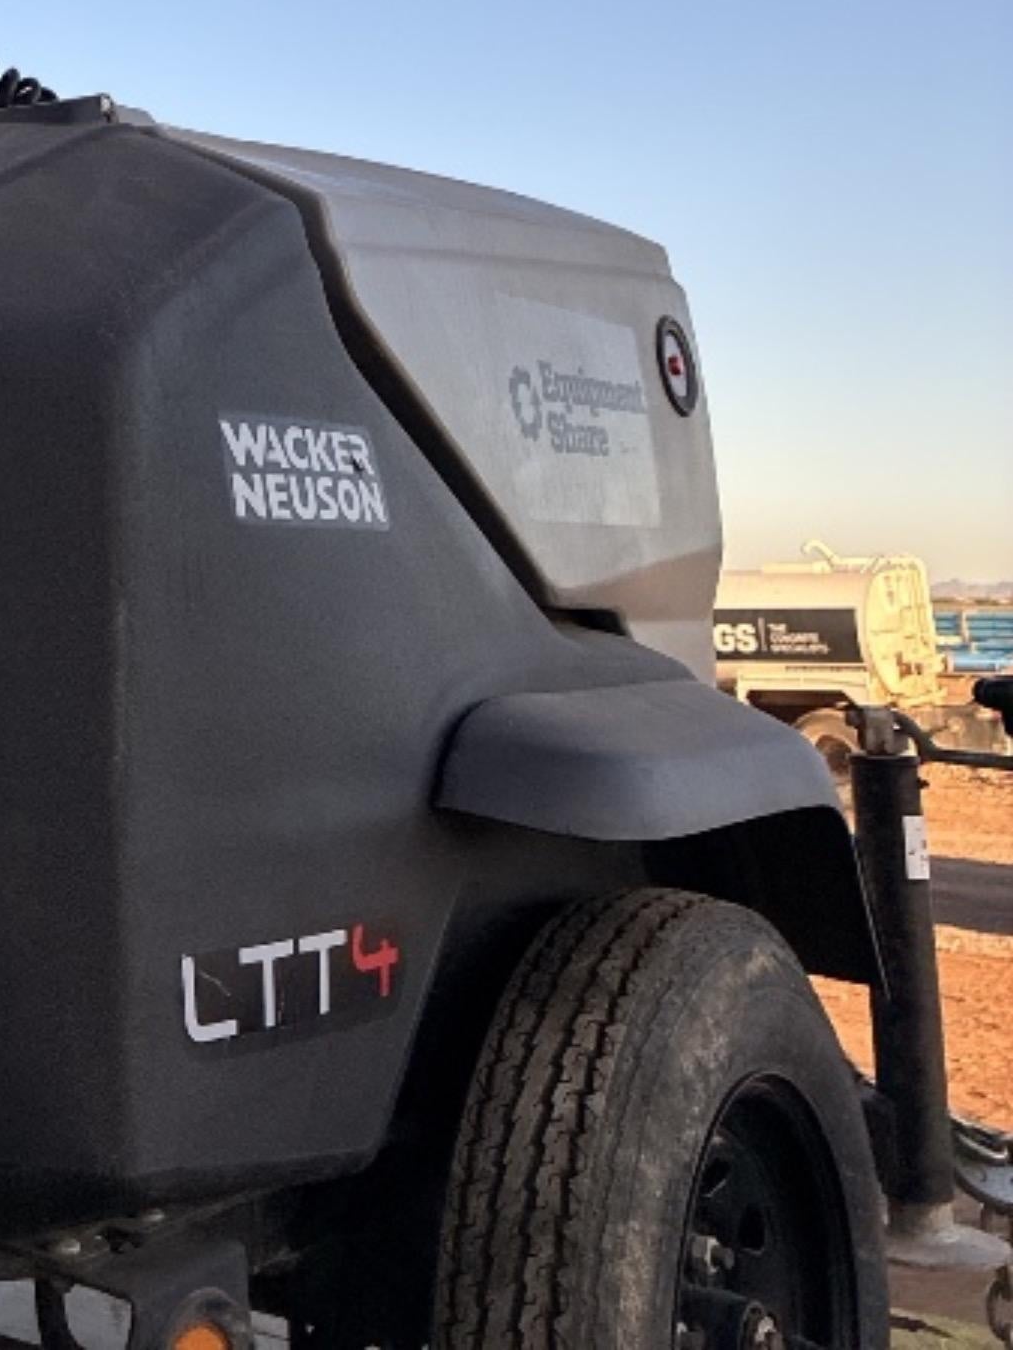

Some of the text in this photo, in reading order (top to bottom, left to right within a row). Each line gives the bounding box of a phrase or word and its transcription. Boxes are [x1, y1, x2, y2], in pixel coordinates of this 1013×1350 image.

[218, 420, 375, 475] WACKER
[548, 411, 610, 456] Share
[231, 473, 388, 523] NEUSON
